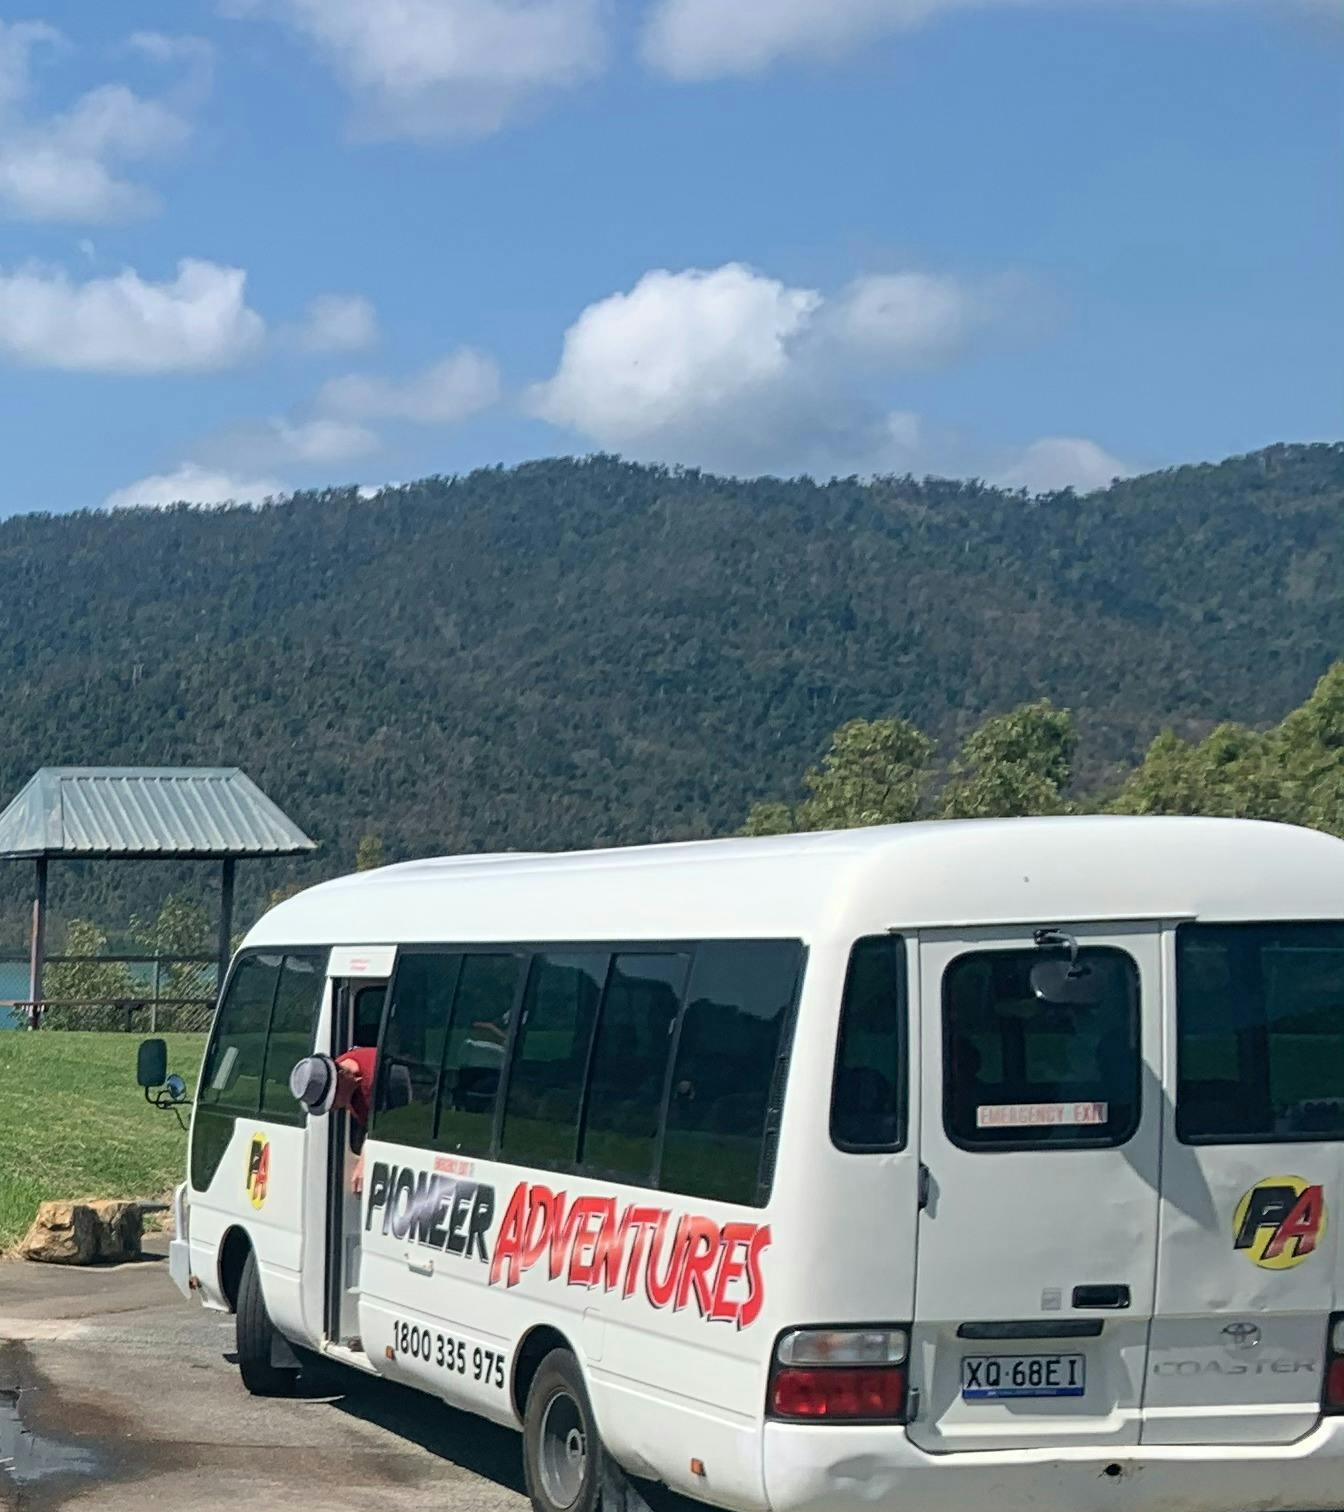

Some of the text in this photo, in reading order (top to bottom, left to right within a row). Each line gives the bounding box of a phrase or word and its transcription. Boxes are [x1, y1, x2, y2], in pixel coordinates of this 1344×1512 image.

[245, 1140, 270, 1200] PA
[365, 1161, 772, 1331] PIONEER ADVENTURES
[1233, 1185, 1324, 1260] PA
[394, 1319, 506, 1390] 1800 335 975
[1153, 1358, 1316, 1375] COASTER
